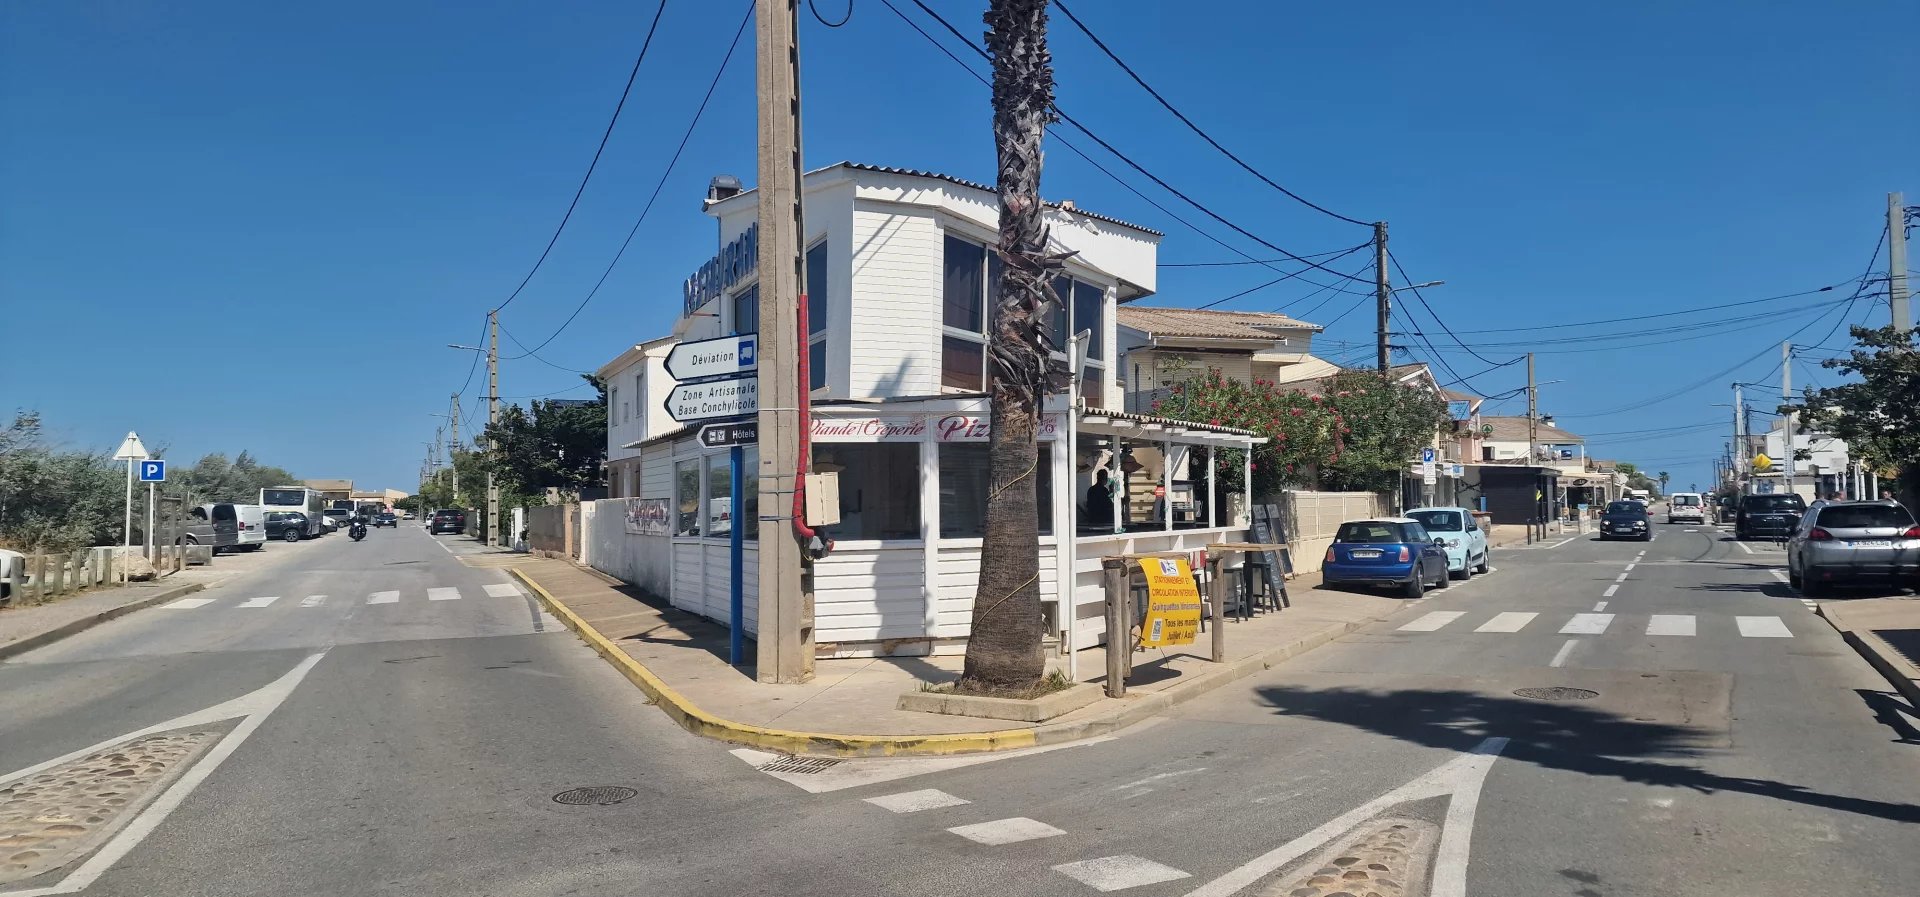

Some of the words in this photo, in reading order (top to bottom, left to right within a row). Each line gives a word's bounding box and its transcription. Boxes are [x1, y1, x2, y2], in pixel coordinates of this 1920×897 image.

[682, 221, 758, 320] RESTAURAN
[692, 352, 734, 366] Déviation
[683, 390, 703, 401] Zone
[708, 382, 756, 398] Artisanale
[678, 405, 697, 416] Base
[701, 398, 756, 414] Conchylicole
[732, 429, 755, 439] Hôtels
[938, 415, 991, 440] Piz
[147, 464, 158, 477] P
[1165, 619, 1176, 627] Tous
[1167, 631, 1181, 640] Juillet
